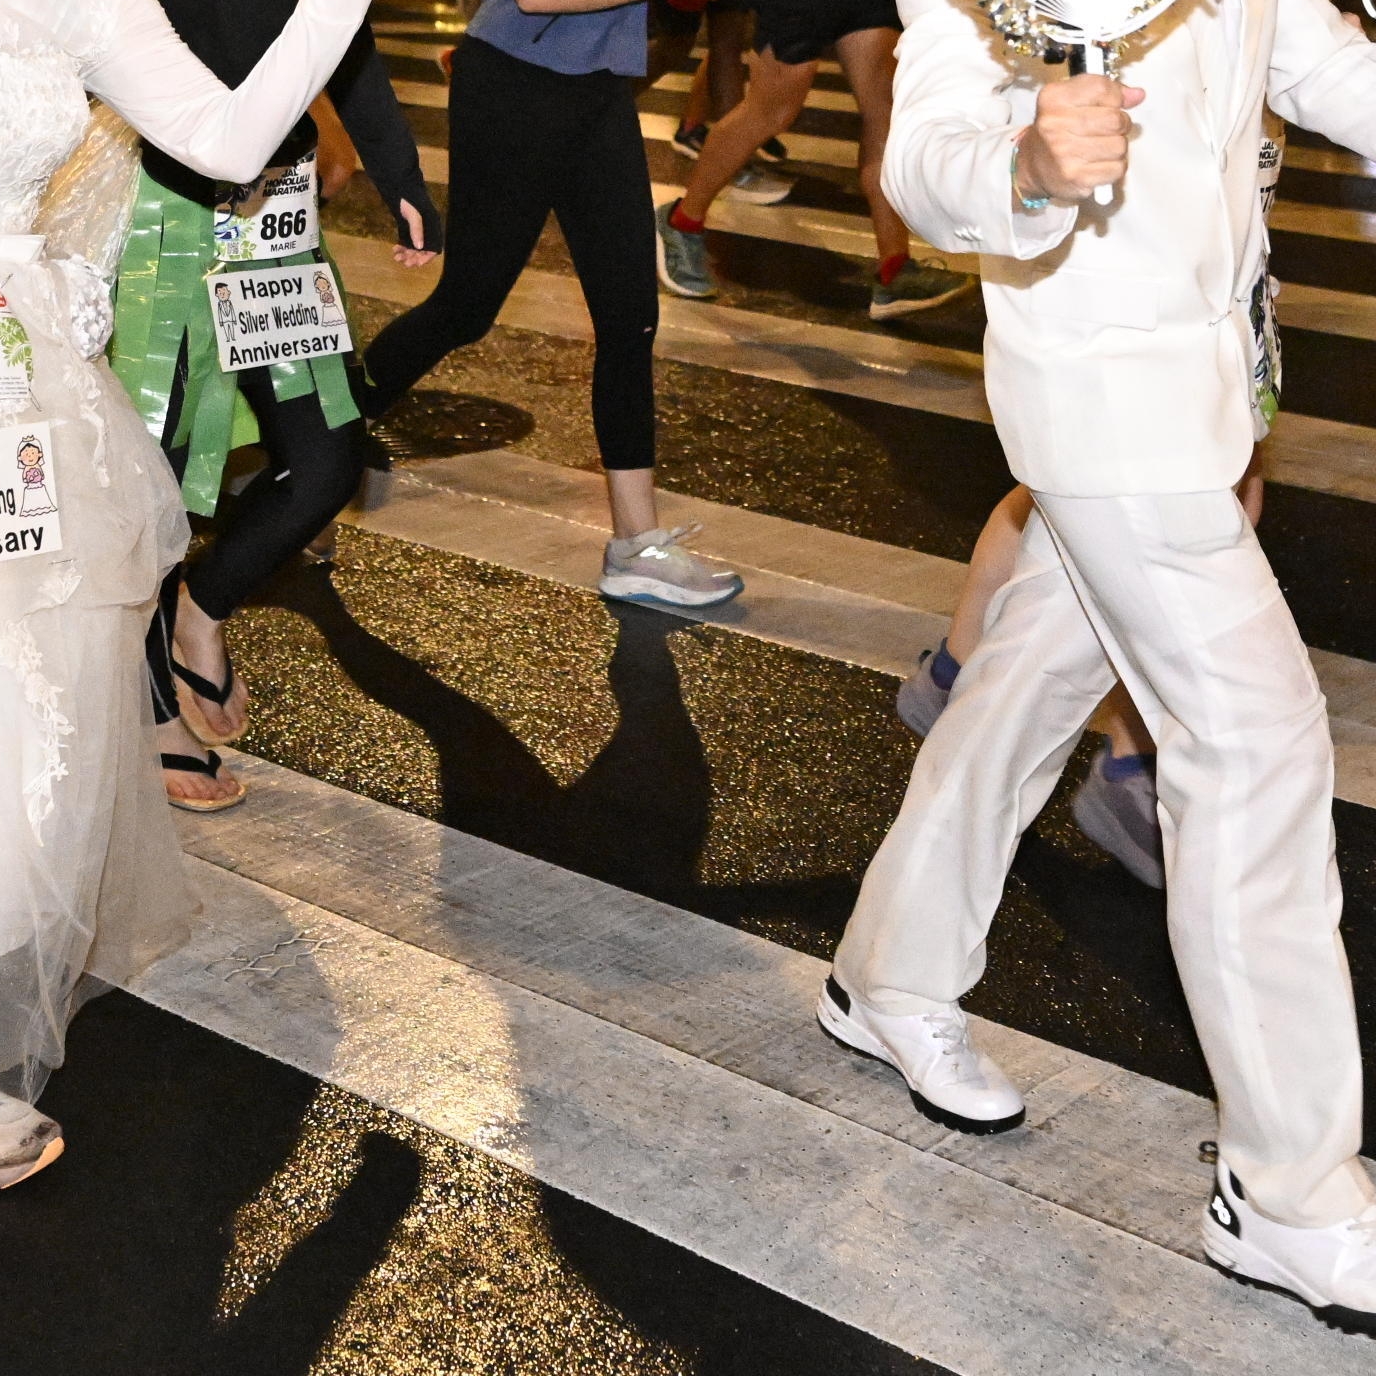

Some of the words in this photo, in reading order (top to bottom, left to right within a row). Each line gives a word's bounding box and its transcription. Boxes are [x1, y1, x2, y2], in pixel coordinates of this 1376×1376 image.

[264, 173, 310, 188] HONOLULU
[283, 167, 299, 178] JAL
[262, 182, 310, 198] MARATHON
[260, 208, 307, 241] 866
[270, 240, 297, 253] MARIE
[239, 276, 303, 300] Happy
[237, 310, 270, 335] Silver
[271, 304, 319, 330] Wedding
[229, 333, 340, 367] Anniversary
